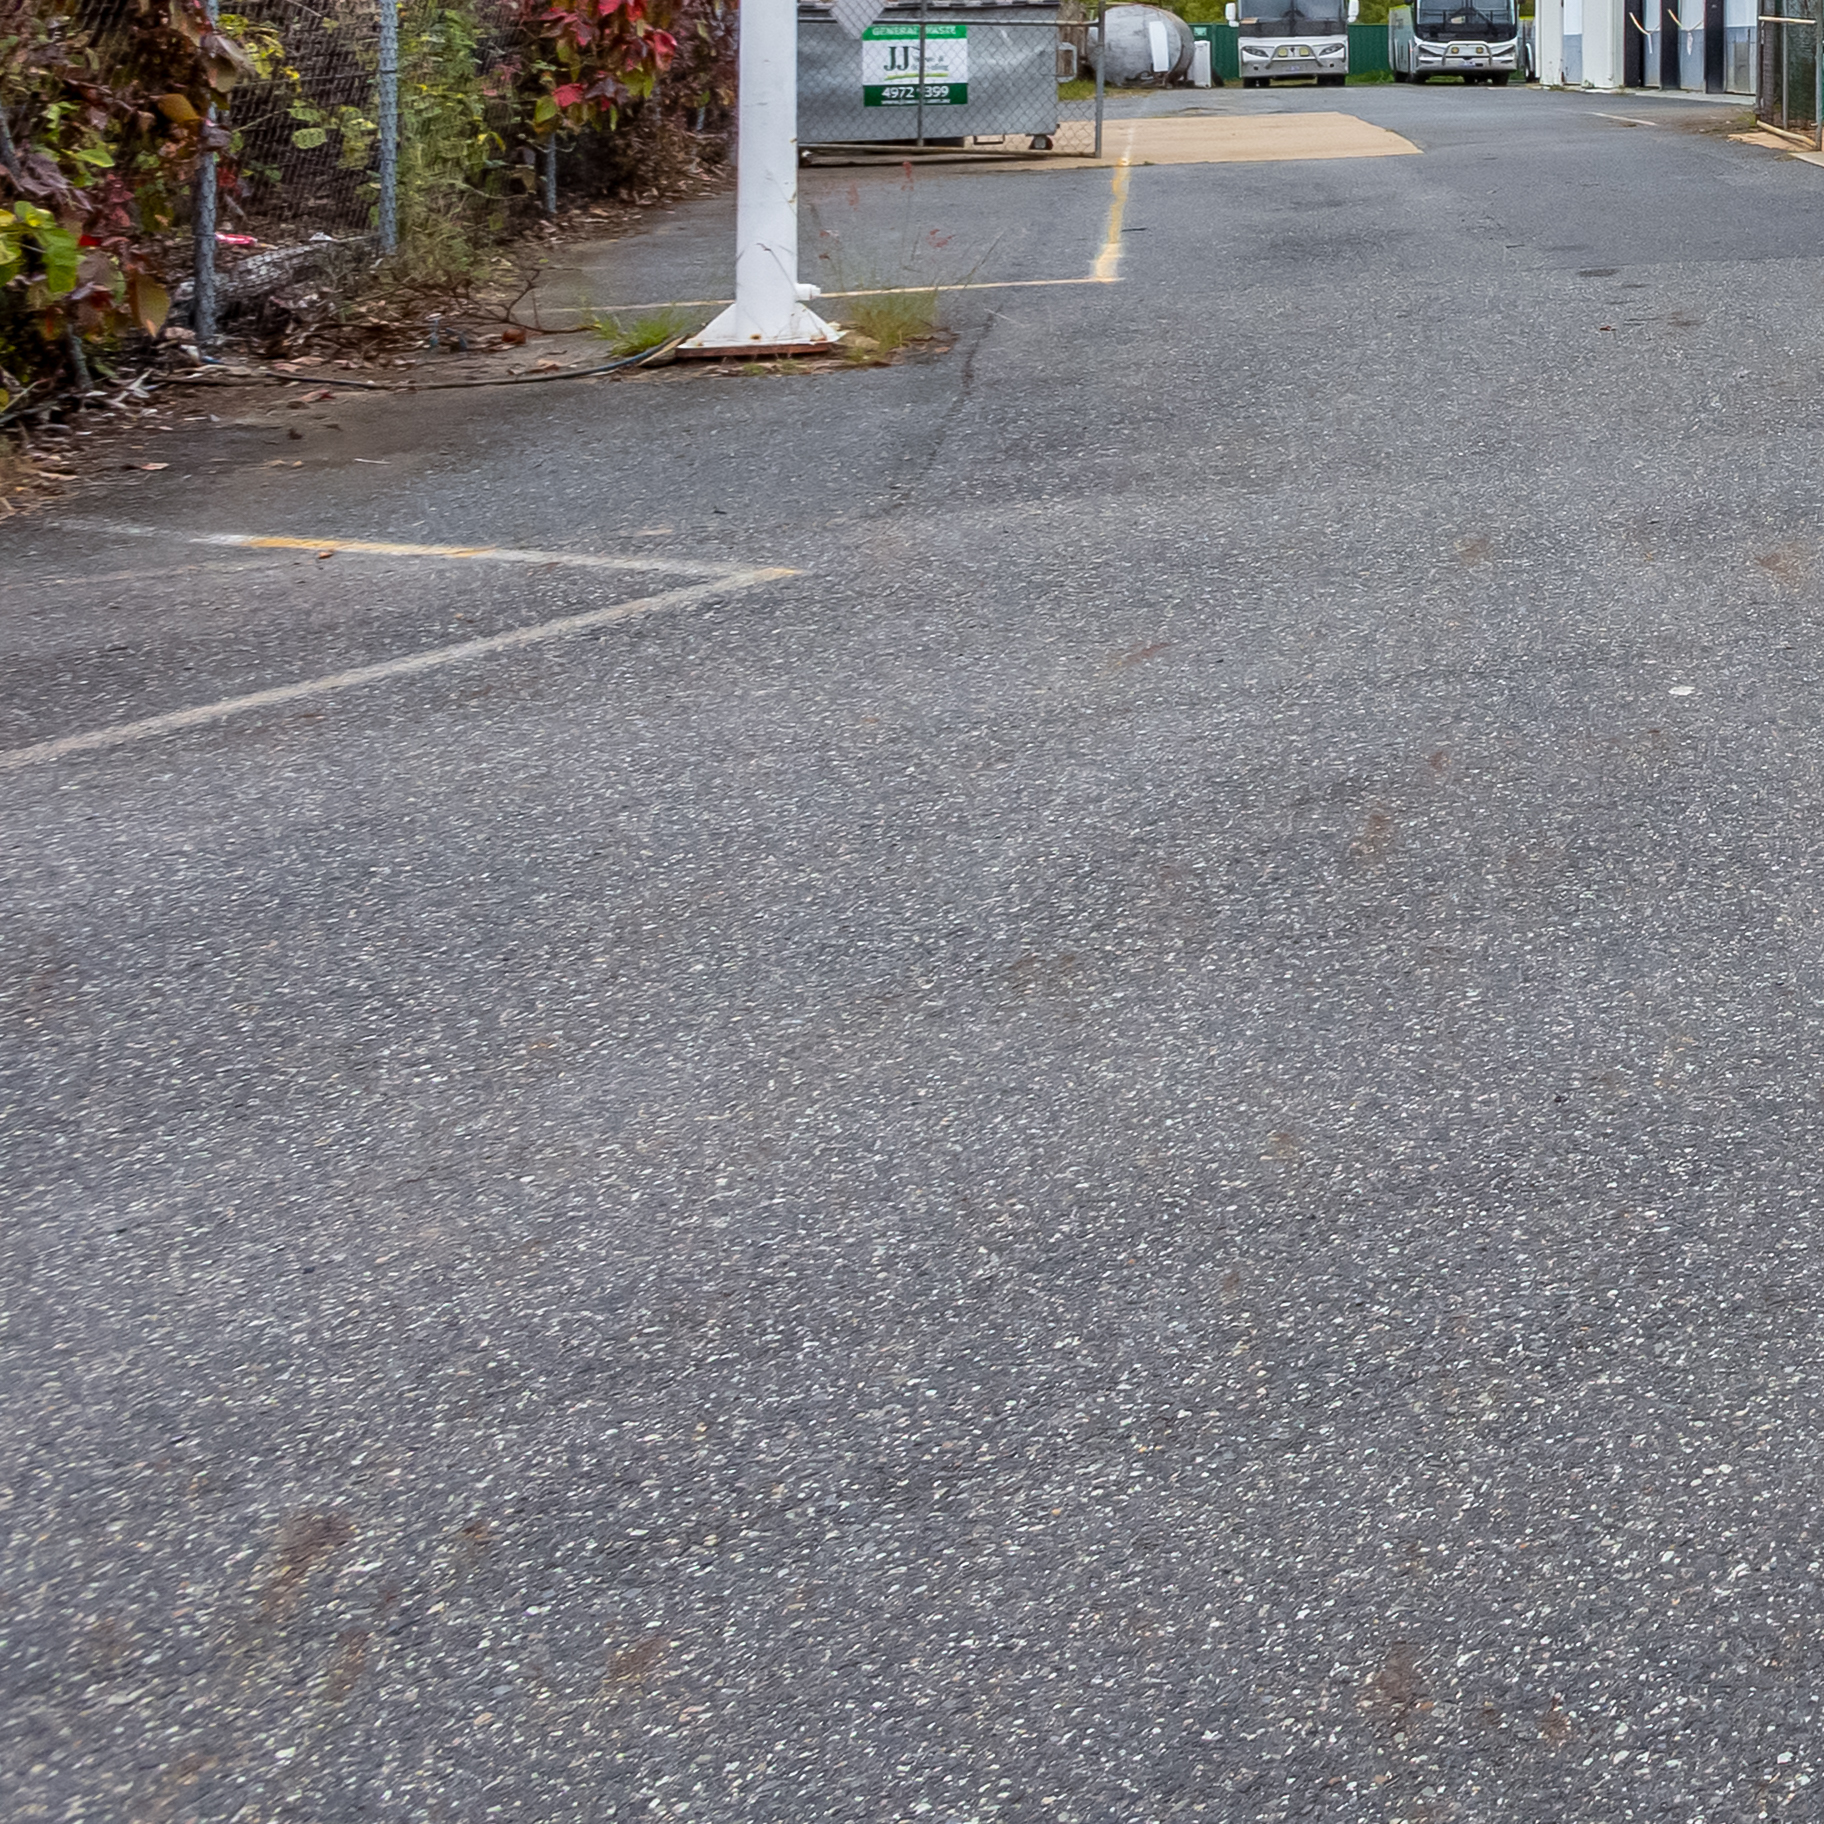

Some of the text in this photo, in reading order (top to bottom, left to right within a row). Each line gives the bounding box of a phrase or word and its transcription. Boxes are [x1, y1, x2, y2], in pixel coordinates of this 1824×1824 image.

[872, 26, 919, 36] GENERAL
[883, 46, 910, 71] JJ
[881, 86, 950, 98] 4972 399
